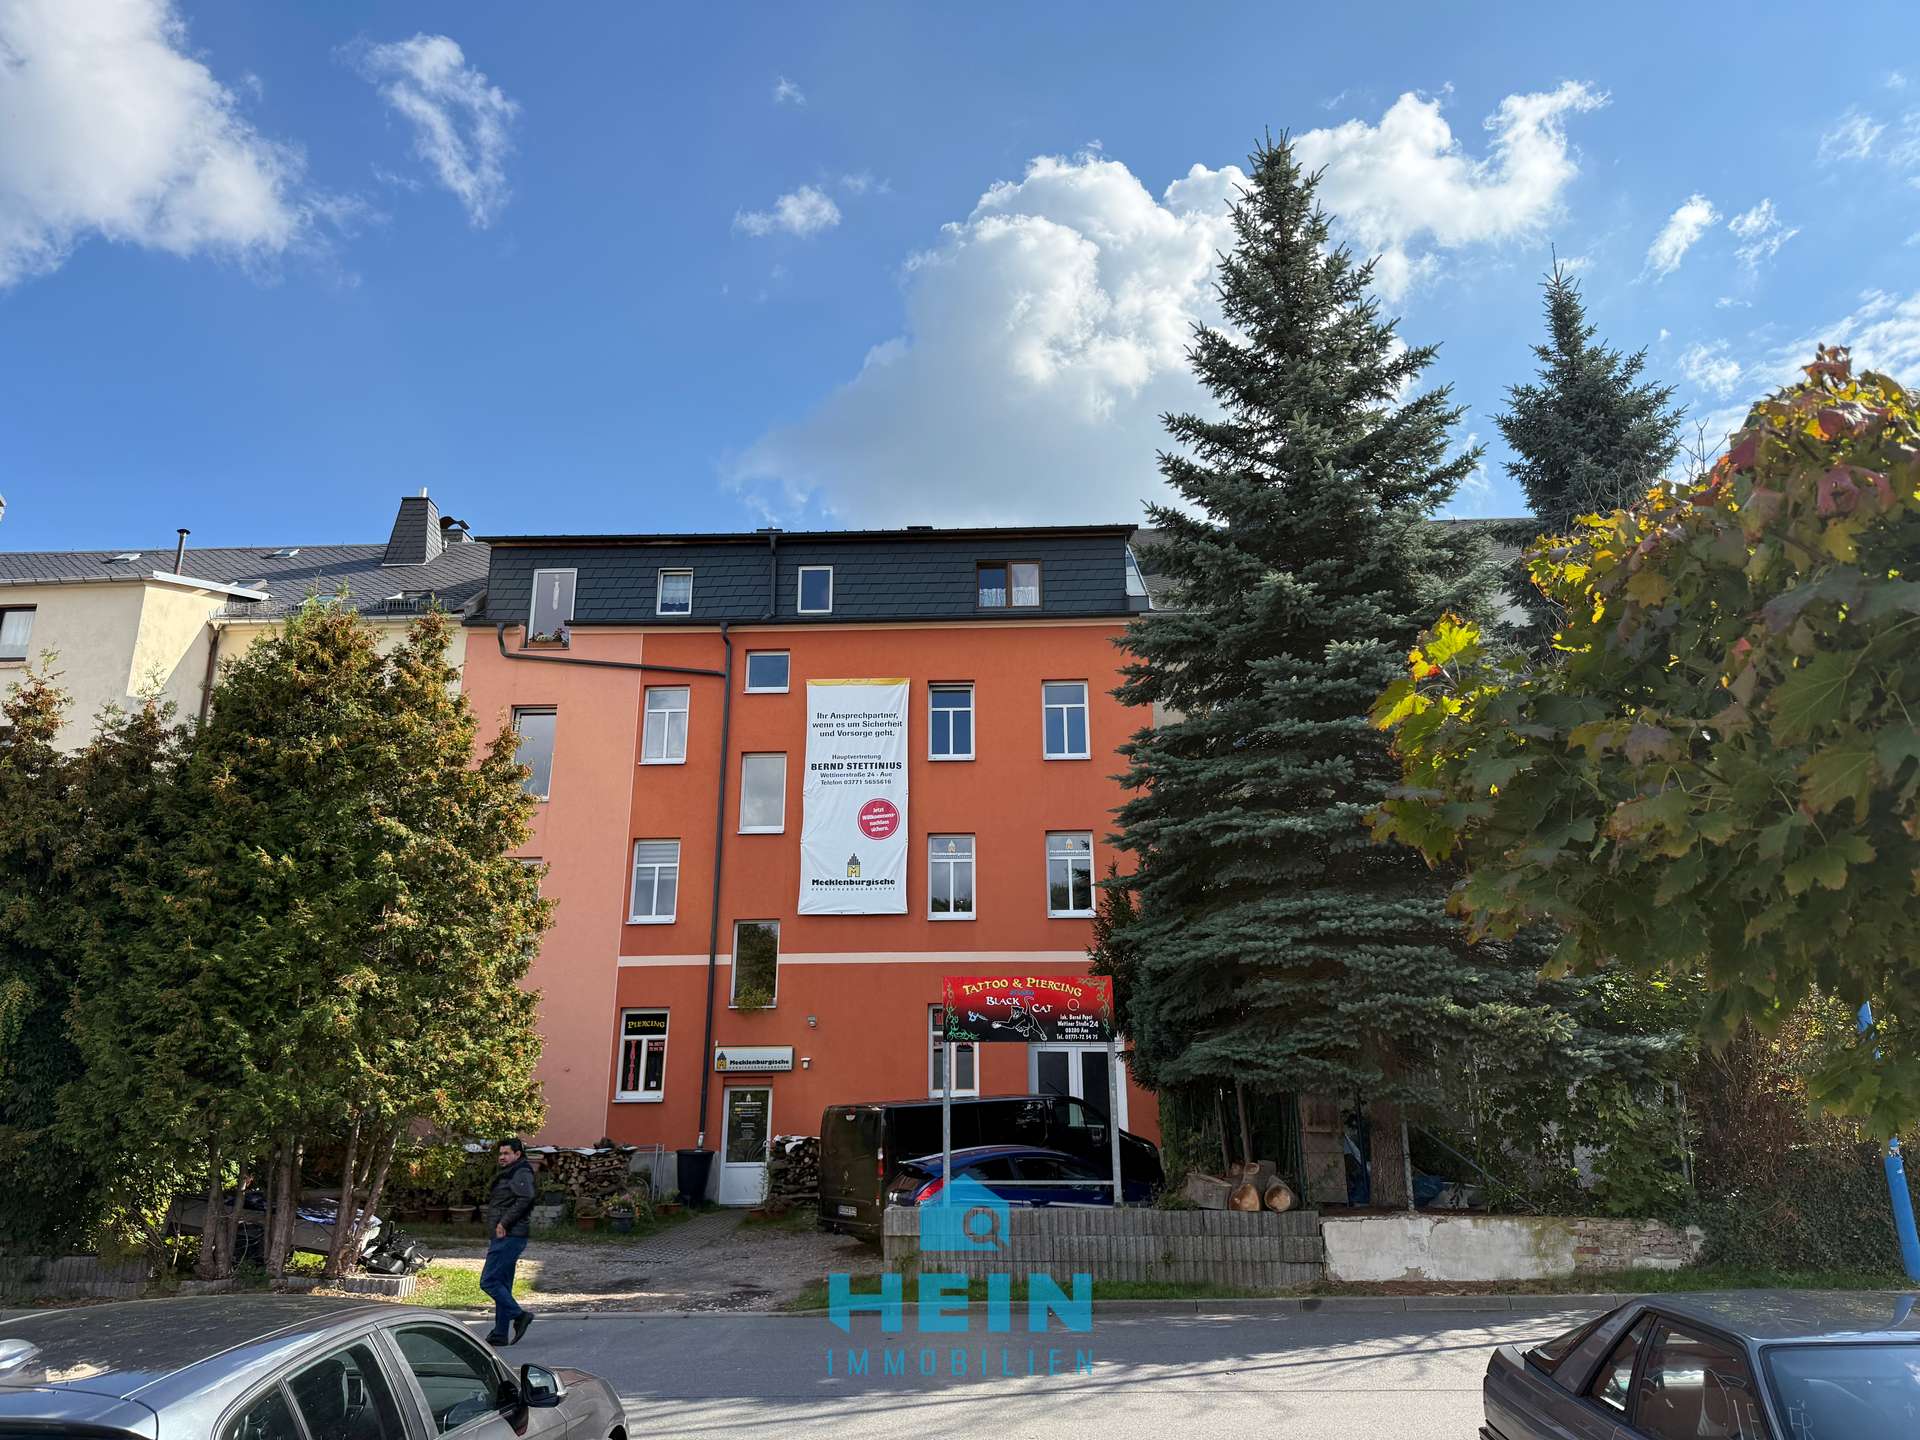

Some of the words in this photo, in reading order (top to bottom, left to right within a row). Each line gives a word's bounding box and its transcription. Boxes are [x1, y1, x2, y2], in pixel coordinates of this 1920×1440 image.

[830, 712, 899, 720] Ansprechpartner,
[862, 720, 903, 728] Sicherheit
[837, 730, 873, 738] Vorsorge
[875, 729, 895, 738] geht.
[810, 763, 844, 771] BERND
[846, 762, 902, 770] STETTINIUS
[811, 879, 896, 887] Mecklenburgische
[962, 978, 1009, 995] TATTOO
[1012, 978, 1024, 989] &
[1026, 977, 1083, 998] PIERCING
[986, 996, 1021, 1006] BLACK
[1032, 1003, 1053, 1013] CAT
[627, 1020, 666, 1029] PIERCING
[1089, 1020, 1099, 1028] 24
